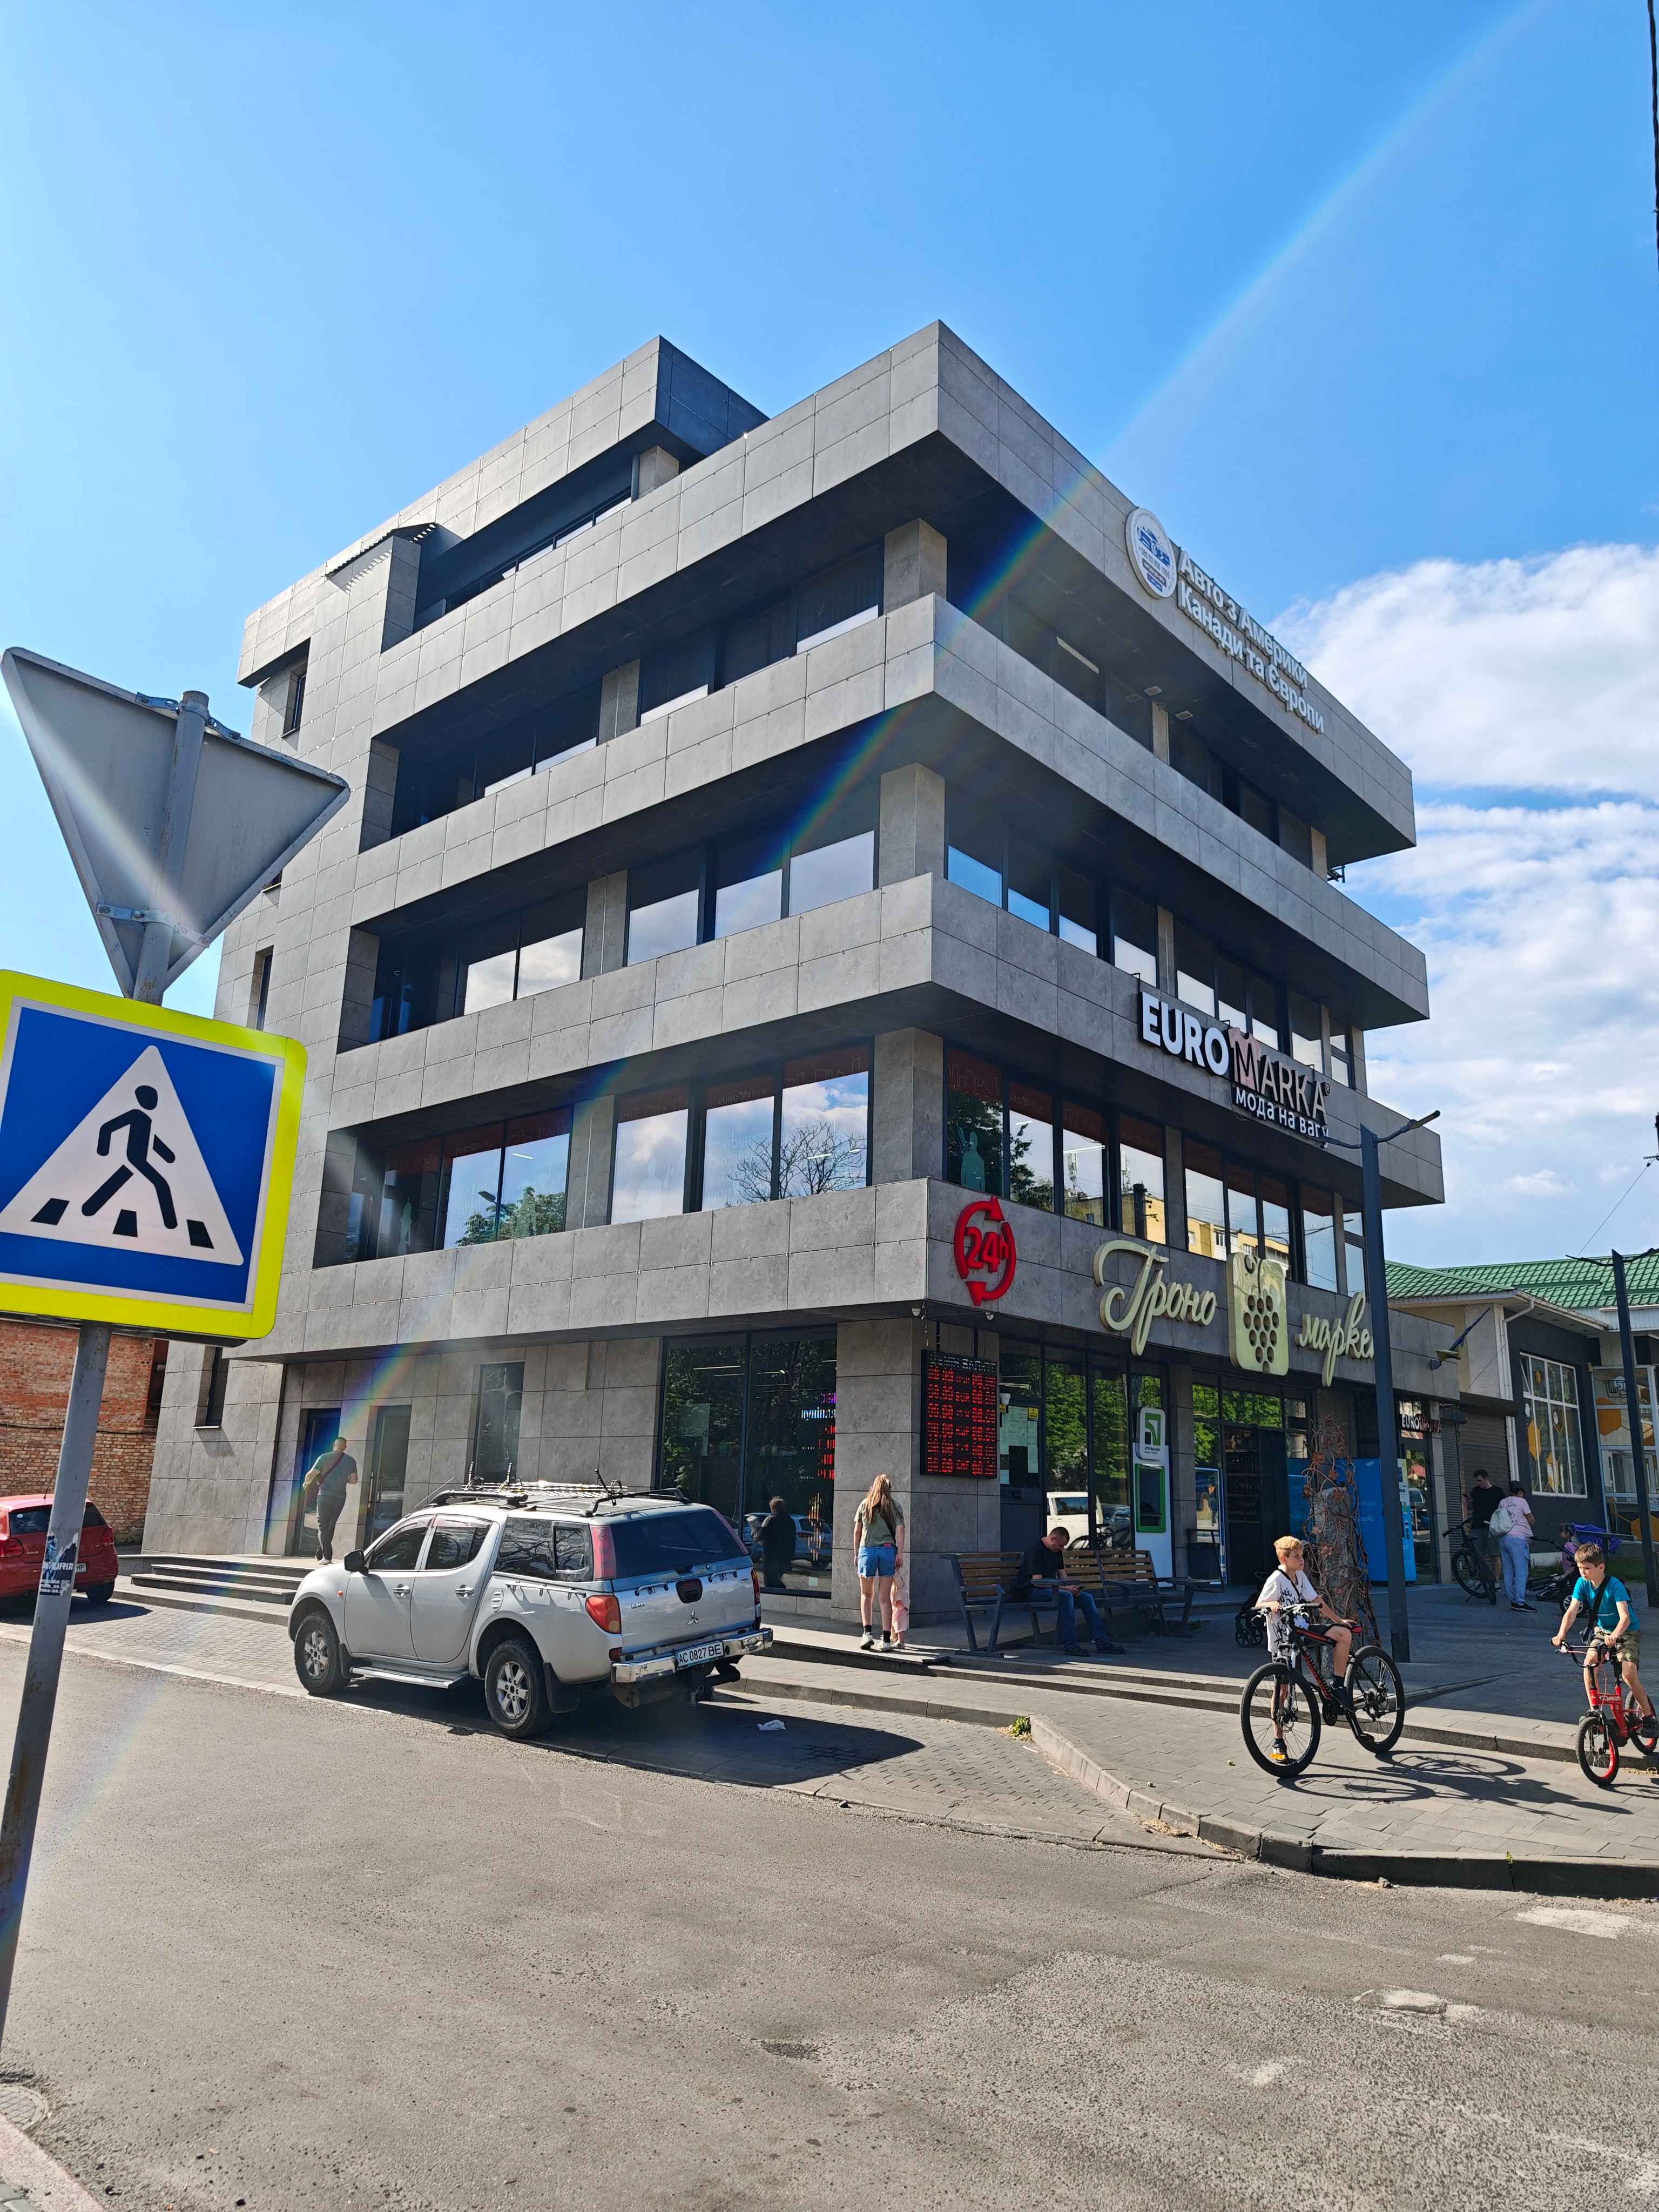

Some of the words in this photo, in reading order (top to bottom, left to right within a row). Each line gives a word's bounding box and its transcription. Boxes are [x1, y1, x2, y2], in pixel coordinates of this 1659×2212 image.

[1179, 551, 1224, 608] Авто
[1226, 599, 1237, 621] з
[1239, 608, 1308, 689] Америки
[1179, 581, 1243, 660] Канади
[1245, 648, 1265, 681] та
[1266, 664, 1324, 734] Європи
[1278, 1107, 1296, 1130] на
[1299, 1115, 1329, 1149] вагу
[963, 1227, 1008, 1273] 24h
[1093, 1240, 1217, 1356] Гроно
[679, 1653, 688, 1664] AC
[689, 1647, 706, 1661] 0827
[708, 1644, 722, 1656] BE
